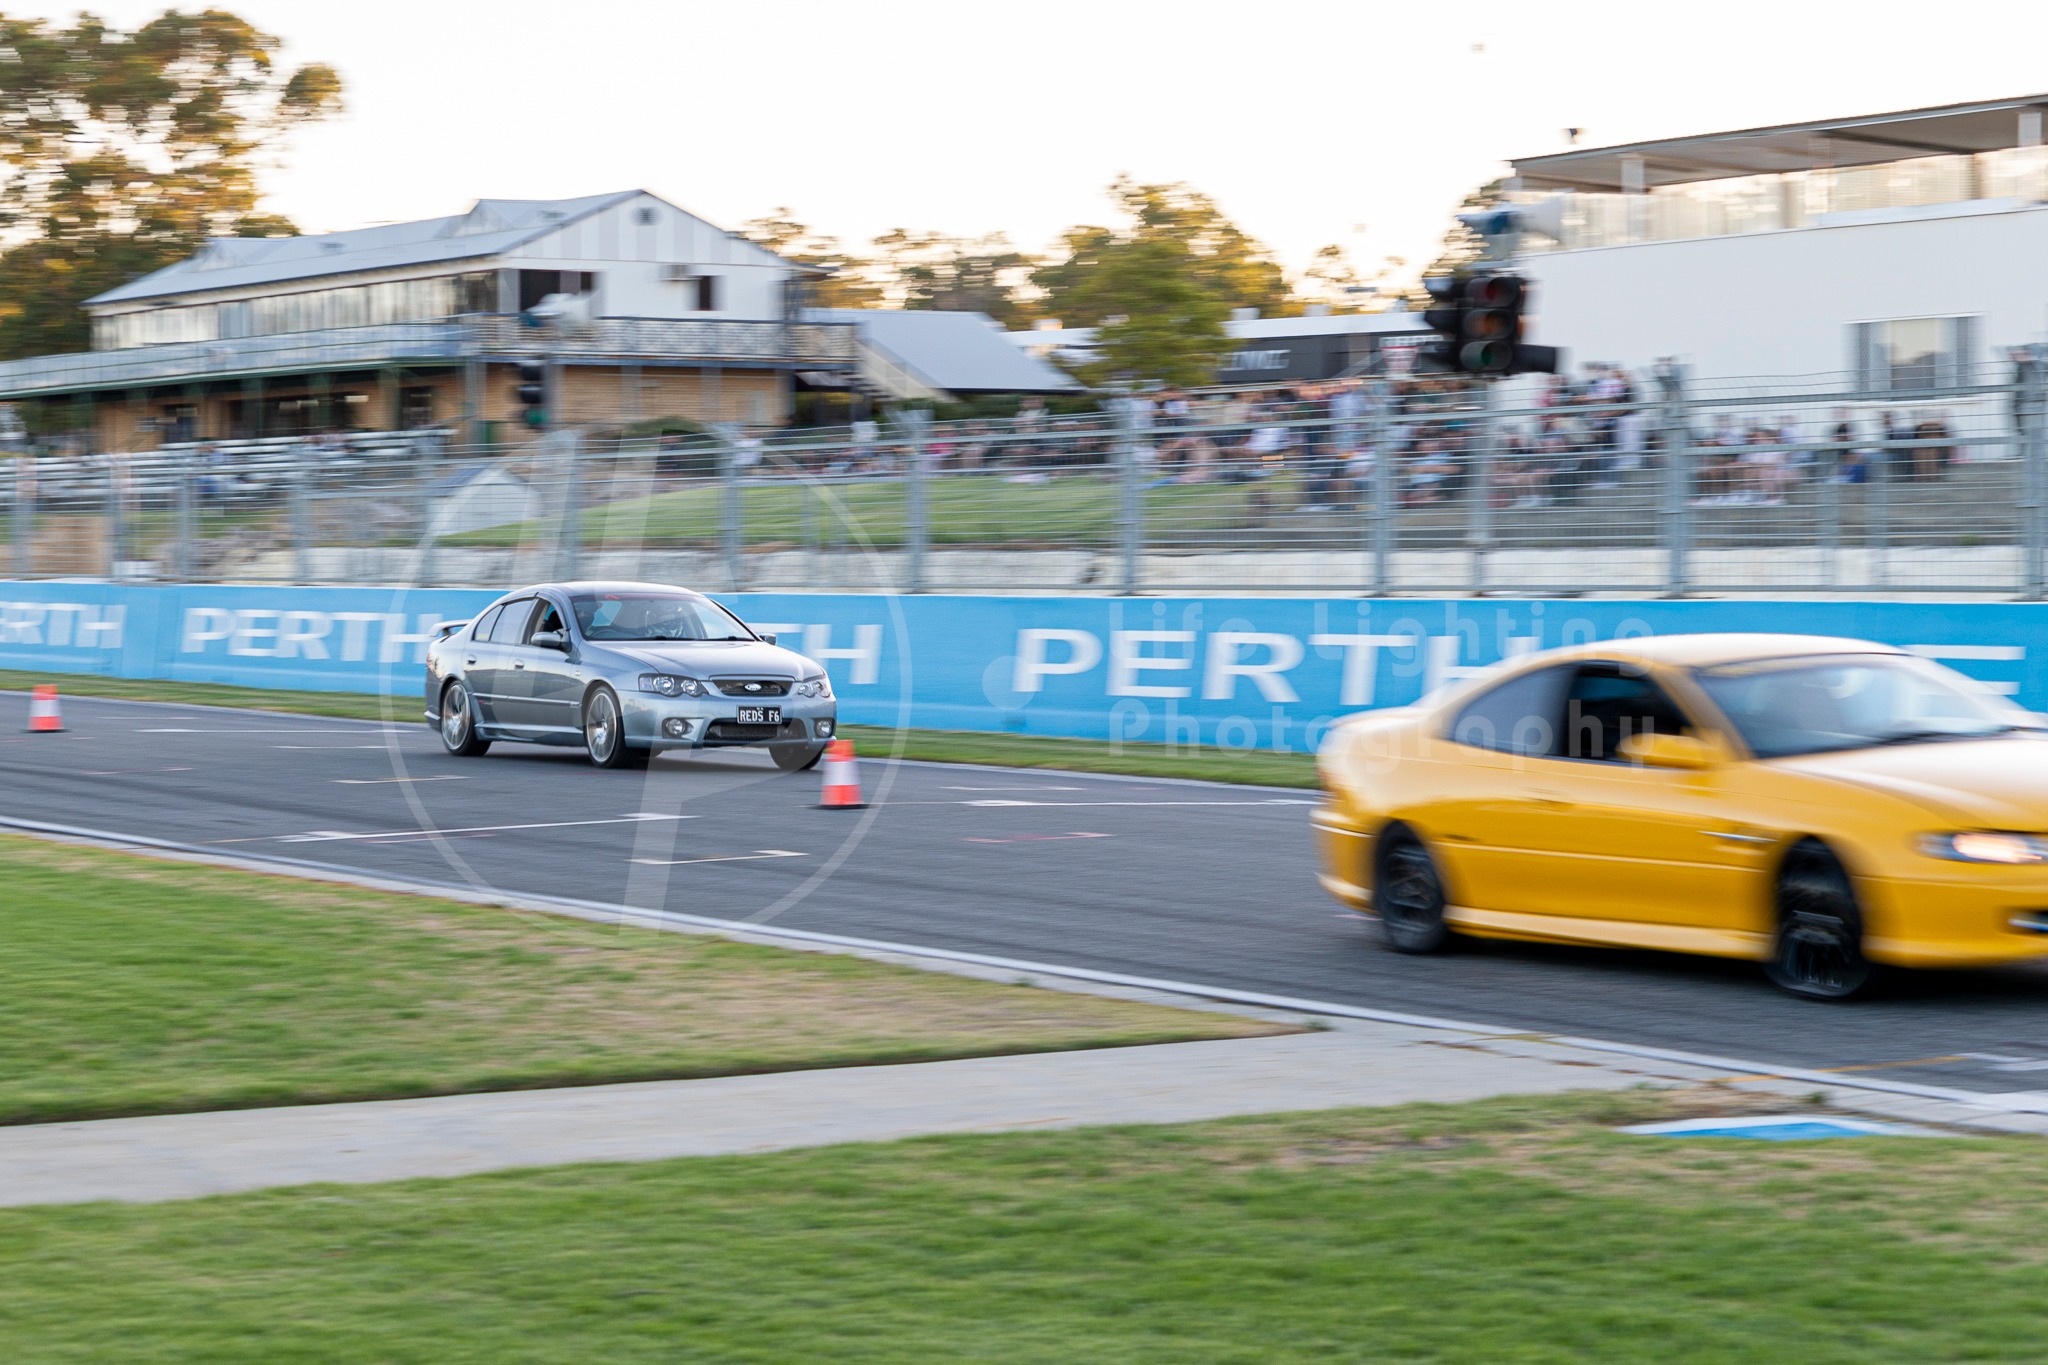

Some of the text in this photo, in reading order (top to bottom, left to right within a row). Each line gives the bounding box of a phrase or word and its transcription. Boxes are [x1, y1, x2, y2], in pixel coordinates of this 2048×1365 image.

[0, 601, 127, 649] RTH
[181, 607, 443, 664] PERTH
[740, 710, 780, 722] REDS F6
